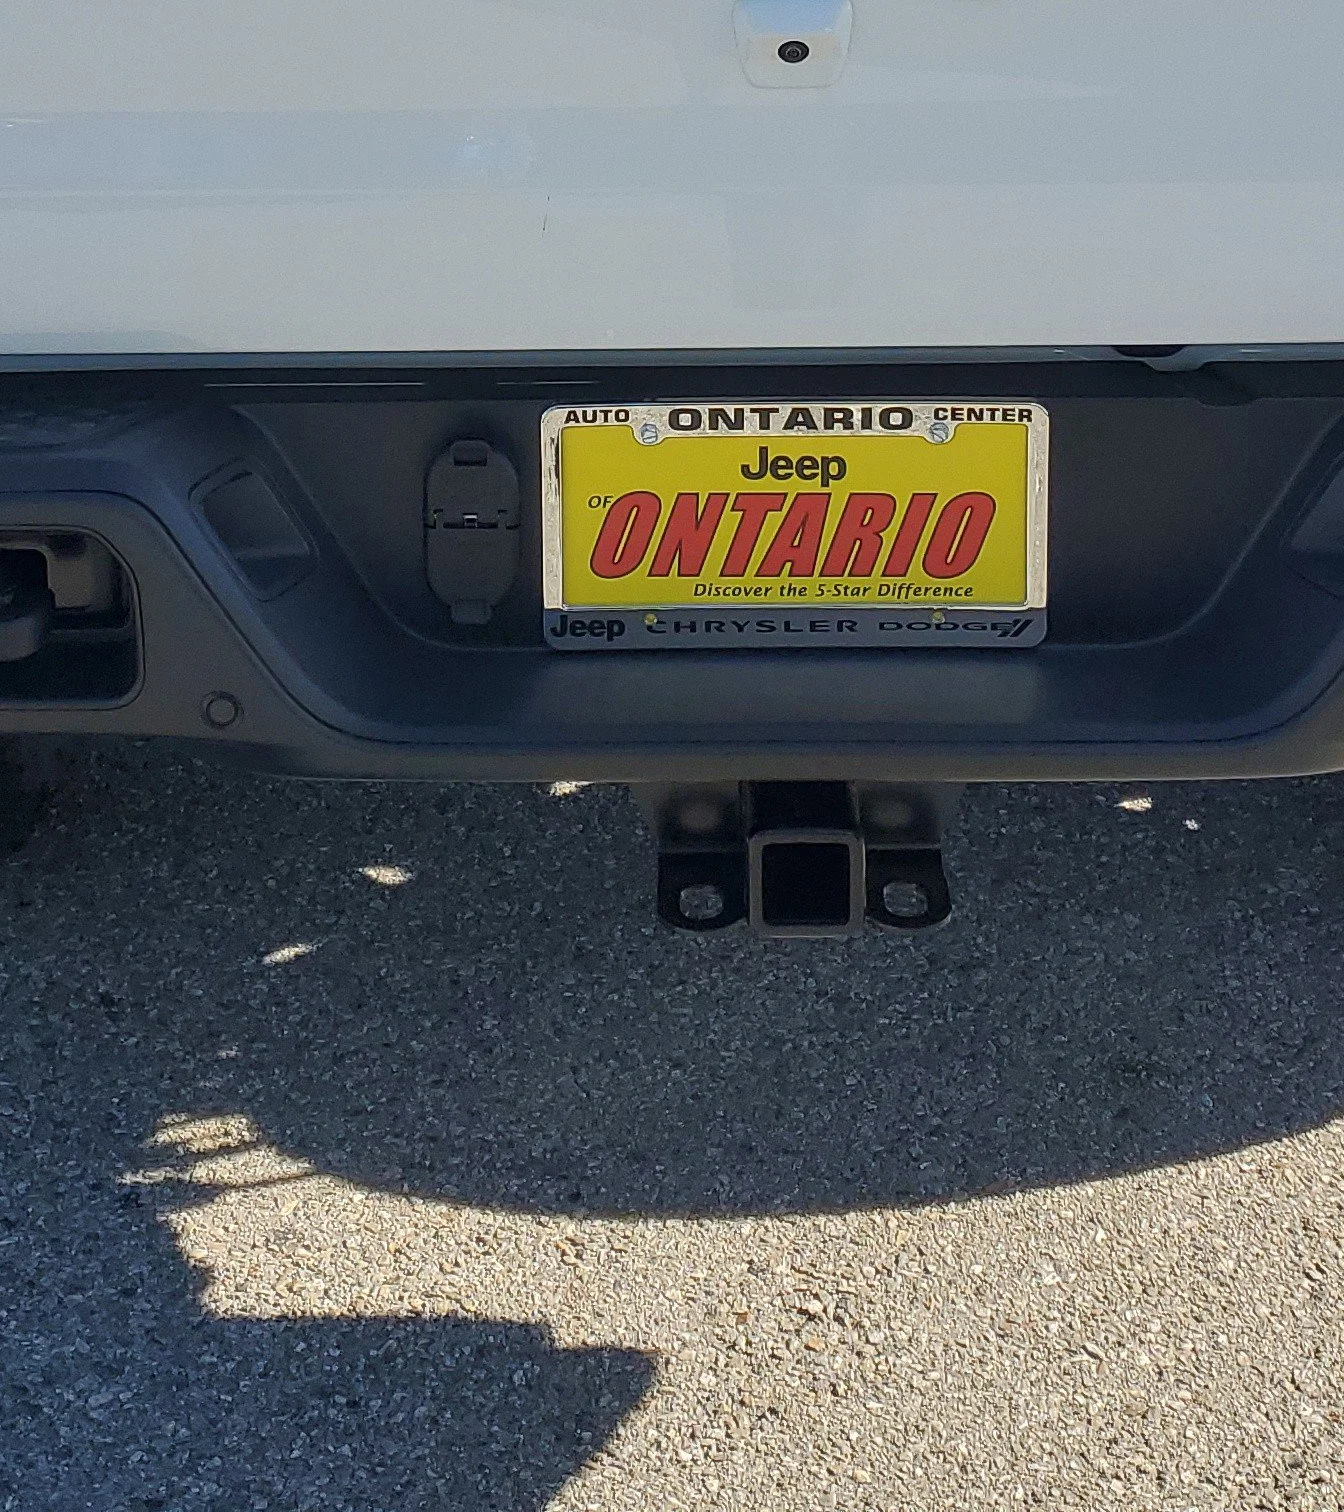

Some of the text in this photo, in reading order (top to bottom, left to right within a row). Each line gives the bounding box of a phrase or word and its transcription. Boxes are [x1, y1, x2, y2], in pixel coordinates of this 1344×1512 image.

[564, 406, 1034, 432] AUTO ONTARIO CENTER
[739, 446, 848, 488] Jeep
[587, 490, 997, 580] OF ONTARIO
[693, 582, 974, 599] Discover the 5-Star Difference
[550, 614, 1011, 642] Jeep CHRYSLER DODGE
